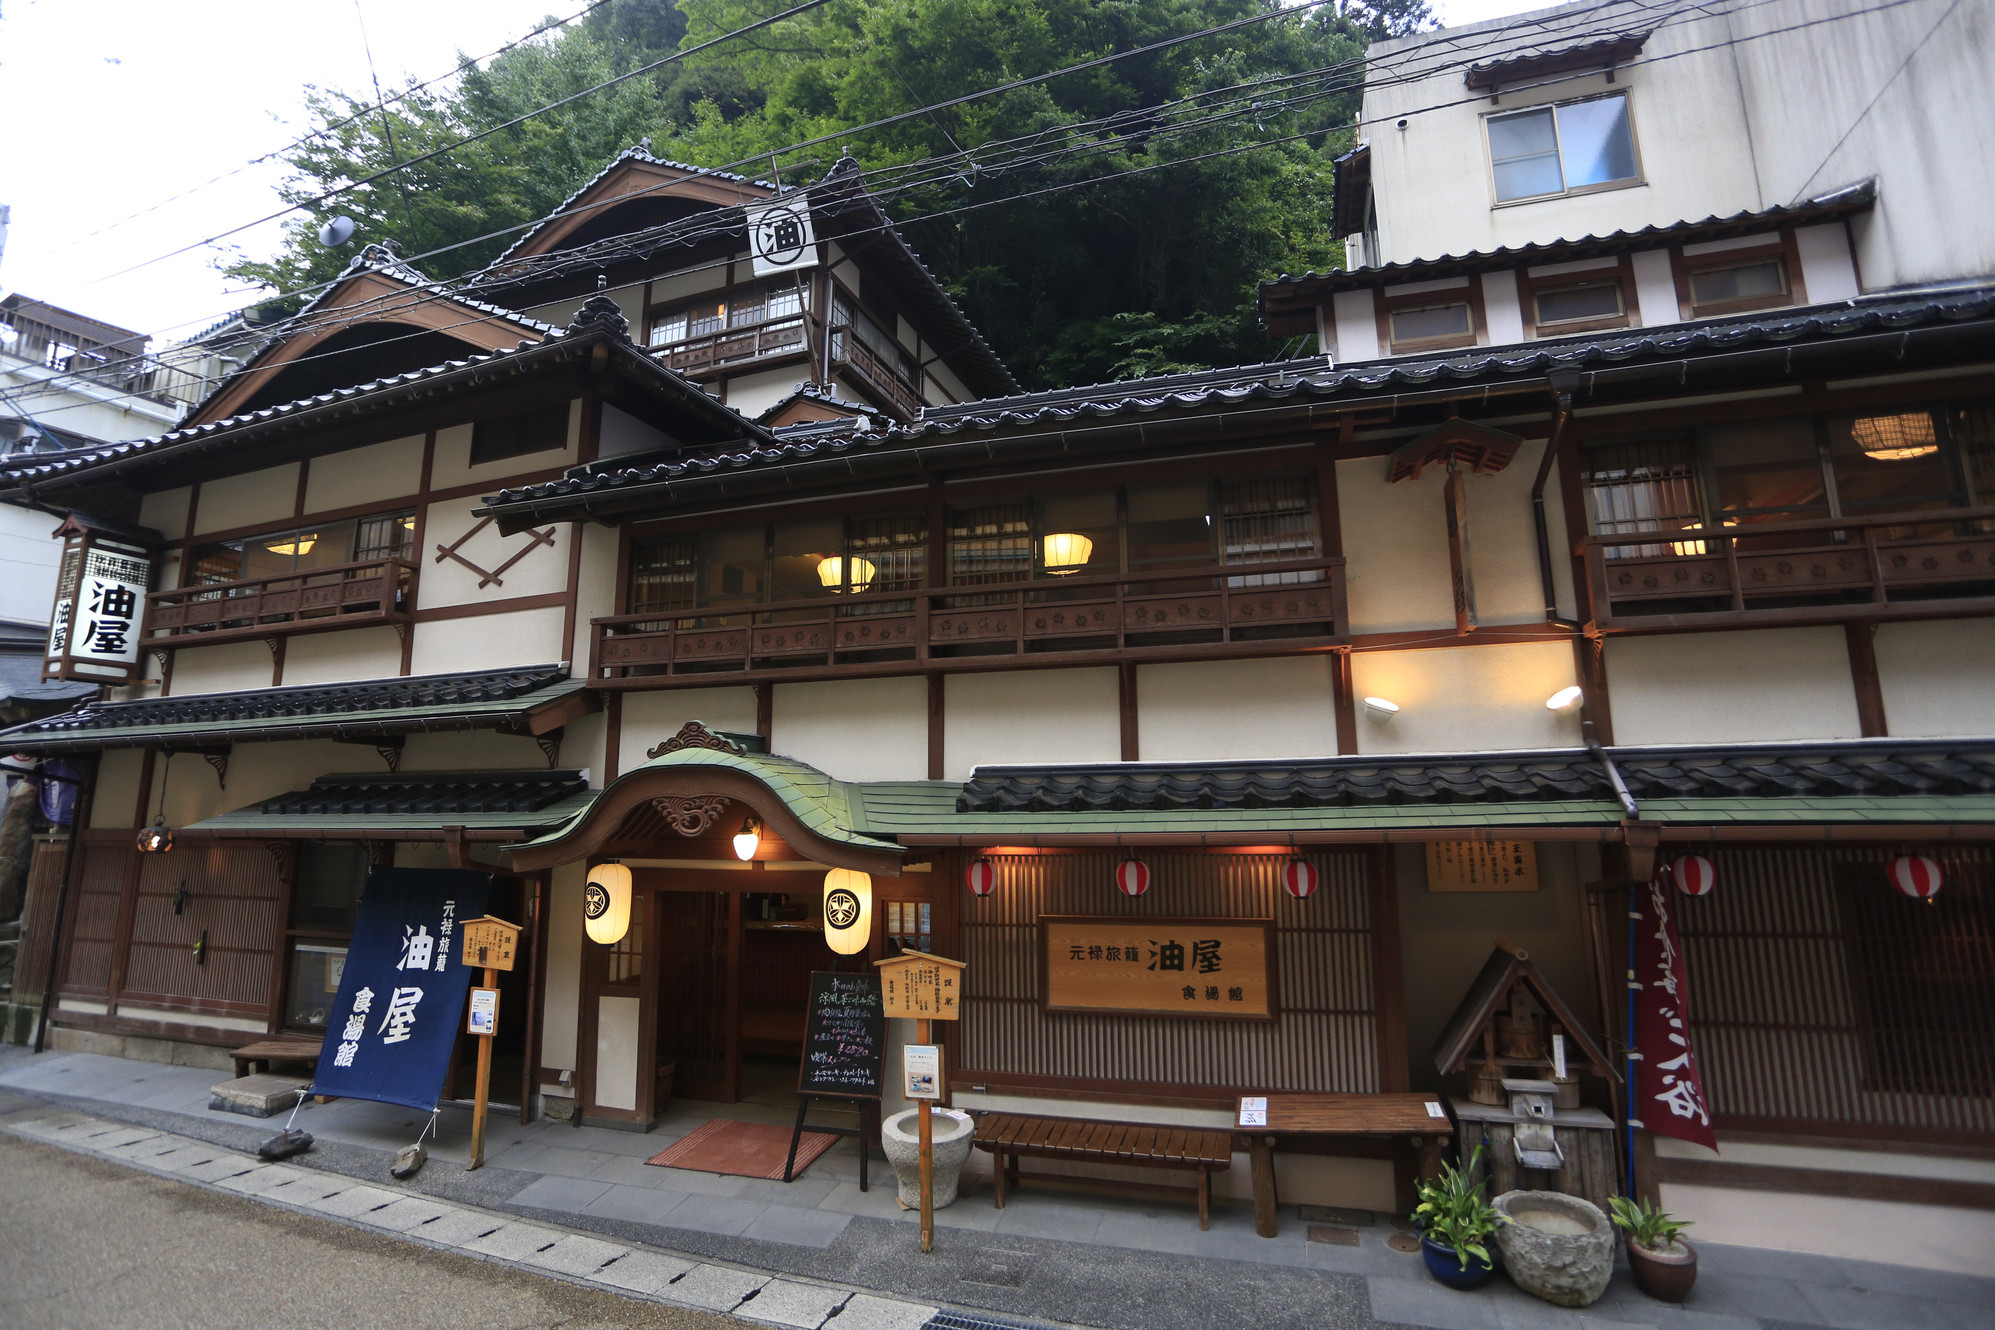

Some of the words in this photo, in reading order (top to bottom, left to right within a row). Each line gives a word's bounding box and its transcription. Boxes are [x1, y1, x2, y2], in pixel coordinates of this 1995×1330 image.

[764, 218, 801, 255] 油
[81, 580, 136, 654] 油屋
[434, 900, 456, 972] 元禄旅籠
[1069, 945, 1140, 962] 元禄旅籠
[1147, 939, 1223, 974] 油屋
[377, 924, 435, 1045] 油屋
